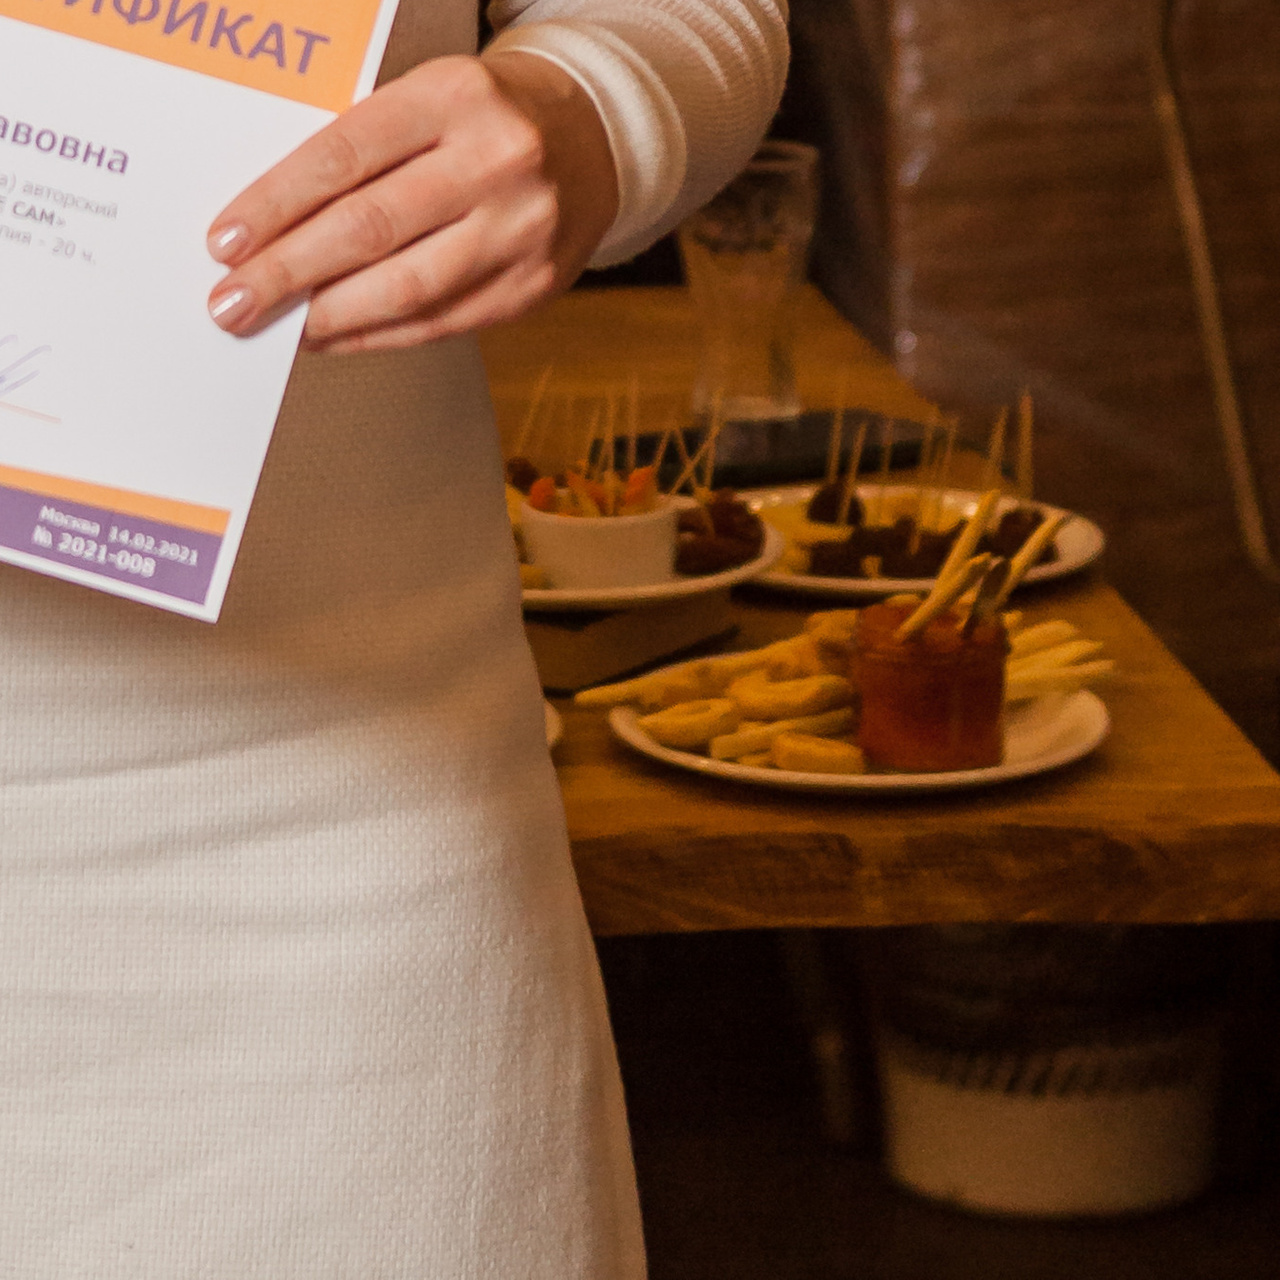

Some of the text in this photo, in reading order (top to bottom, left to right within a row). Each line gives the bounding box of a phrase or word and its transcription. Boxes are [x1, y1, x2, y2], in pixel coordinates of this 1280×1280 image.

[12, 201, 65, 226] САМ»
[22, 183, 118, 219] авторский
[51, 238, 77, 259] 20
[39, 505, 199, 567] Москва 14.02.2021
[57, 532, 157, 578] 2021-008
